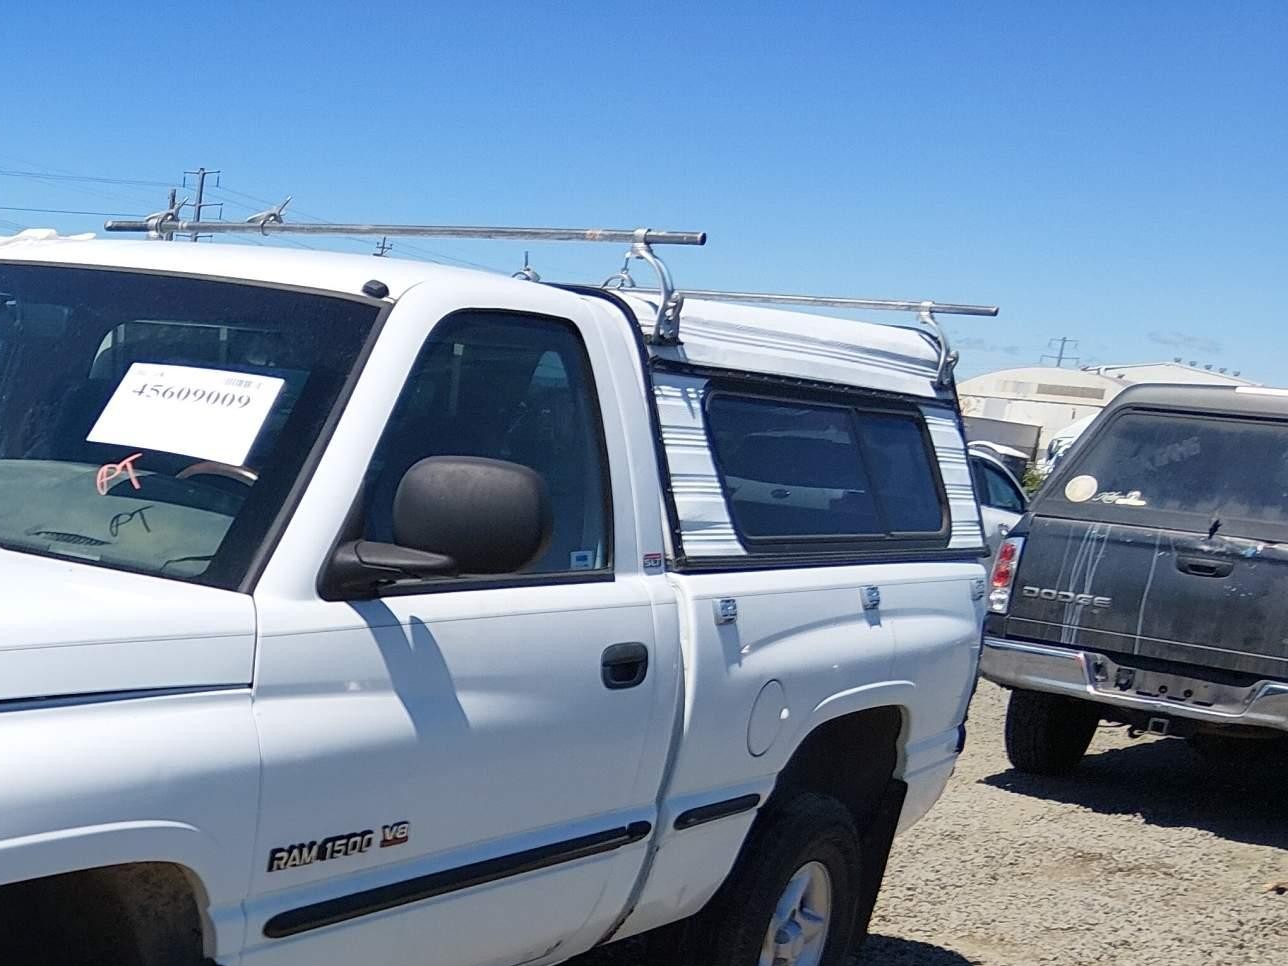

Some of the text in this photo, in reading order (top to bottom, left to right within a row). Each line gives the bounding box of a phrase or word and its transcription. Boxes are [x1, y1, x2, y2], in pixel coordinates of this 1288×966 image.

[131, 383, 252, 409] 45609009
[1022, 585, 1112, 609] DODGE
[268, 821, 410, 872] RAM 1500 V8
